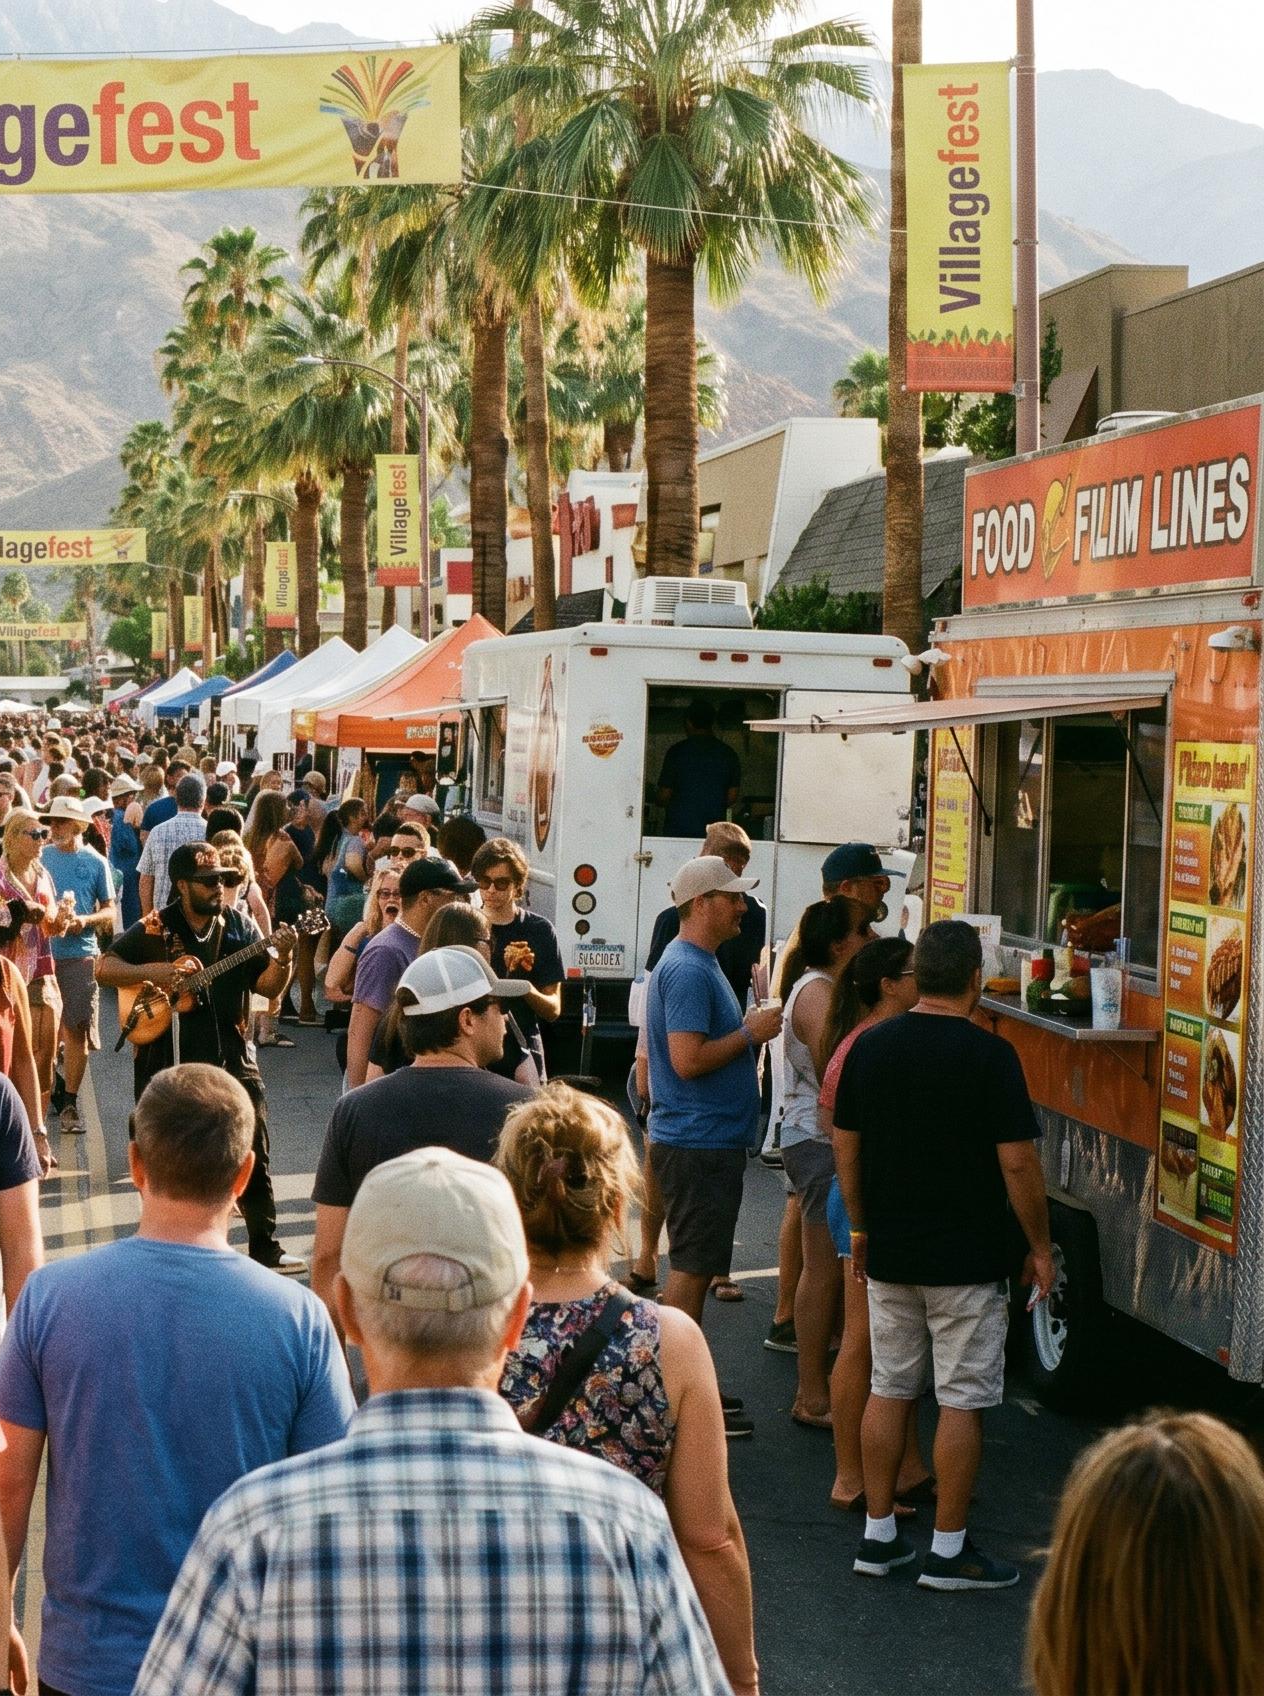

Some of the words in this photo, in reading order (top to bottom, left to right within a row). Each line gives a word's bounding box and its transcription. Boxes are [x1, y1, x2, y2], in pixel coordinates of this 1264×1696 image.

[937, 82, 991, 314] Villagefest
[389, 463, 412, 557] Villagefest
[970, 502, 1036, 577] FOOD
[1150, 456, 1250, 550] LINES
